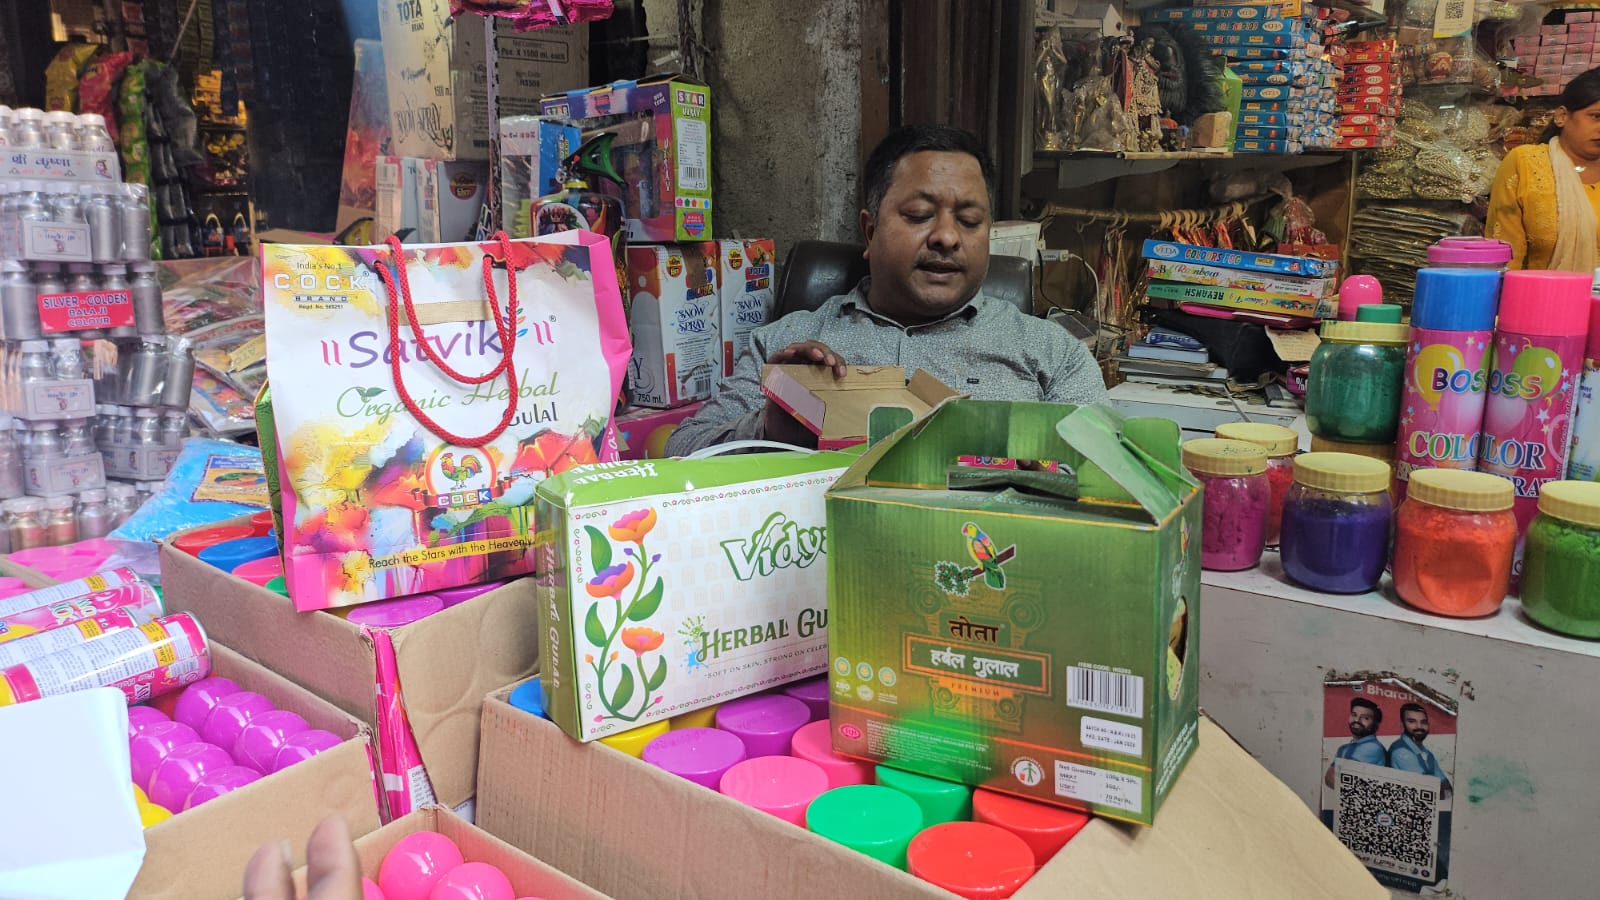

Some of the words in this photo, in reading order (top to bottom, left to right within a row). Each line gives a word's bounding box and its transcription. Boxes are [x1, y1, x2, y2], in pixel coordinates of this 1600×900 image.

[678, 91, 705, 106] STAR
[1184, 248, 1223, 262] COLOURS
[274, 273, 368, 291] COCK
[43, 295, 79, 309] SILVER
[87, 293, 129, 305] GOLDEN
[1184, 287, 1225, 301] REYANSH
[675, 303, 706, 318] SNOW
[68, 317, 111, 328] COLOUR
[348, 320, 506, 369] Satvik
[336, 386, 451, 425] Organic
[437, 491, 492, 506] COCK
[368, 553, 400, 569] Reach
[402, 552, 419, 563] the
[421, 549, 446, 562] Stars
[449, 544, 468, 556] with
[470, 541, 486, 552] the
[949, 616, 999, 643] तोता
[696, 618, 789, 663] HERBAL
[972, 656, 1020, 678] गुलाल
[951, 682, 1001, 697] PREMIUM
